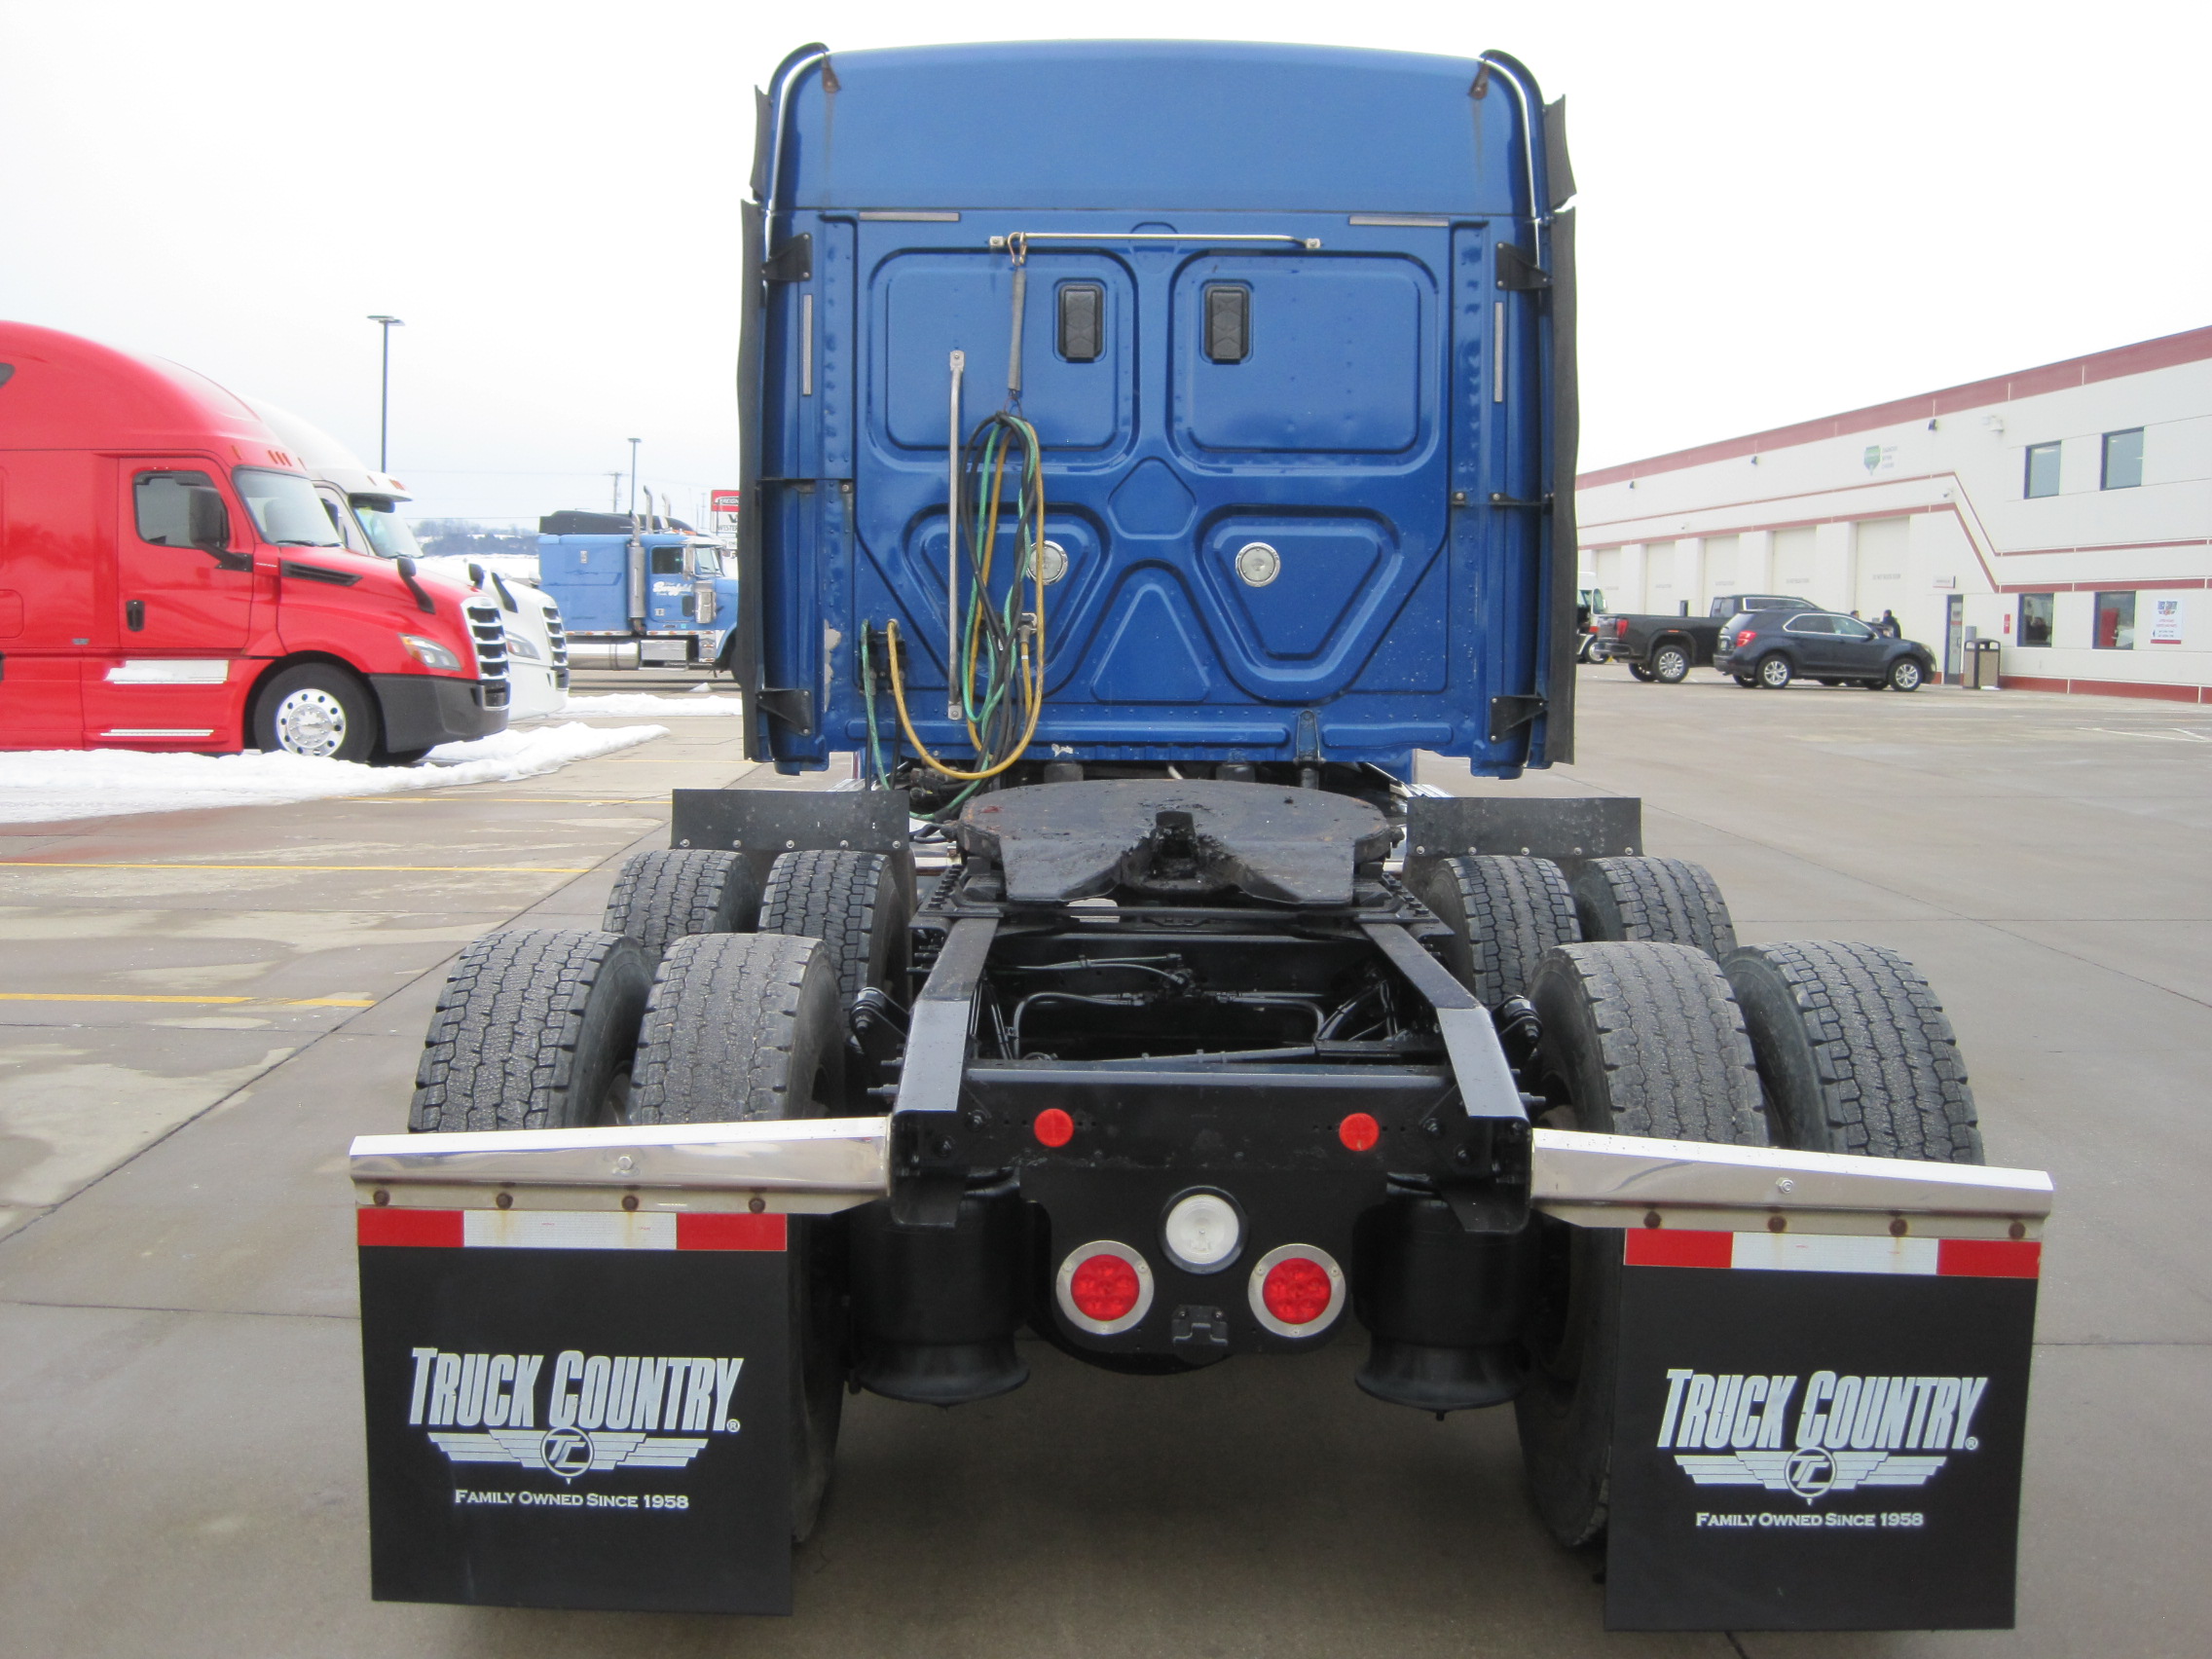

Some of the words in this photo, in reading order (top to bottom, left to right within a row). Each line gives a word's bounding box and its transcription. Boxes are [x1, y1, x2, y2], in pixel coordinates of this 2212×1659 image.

[409, 1347, 544, 1427] TRUCK
[1657, 1368, 1798, 1449] TRUCK
[454, 1489, 516, 1504] FAMILY
[518, 1491, 584, 1506] OWNED
[586, 1493, 639, 1508] SINCE
[643, 1493, 689, 1509] 1958
[1695, 1512, 1756, 1528] FAMILY
[1757, 1512, 1824, 1528] OWNED
[1825, 1512, 1876, 1528] SINCE
[1879, 1512, 1925, 1528] 1958
